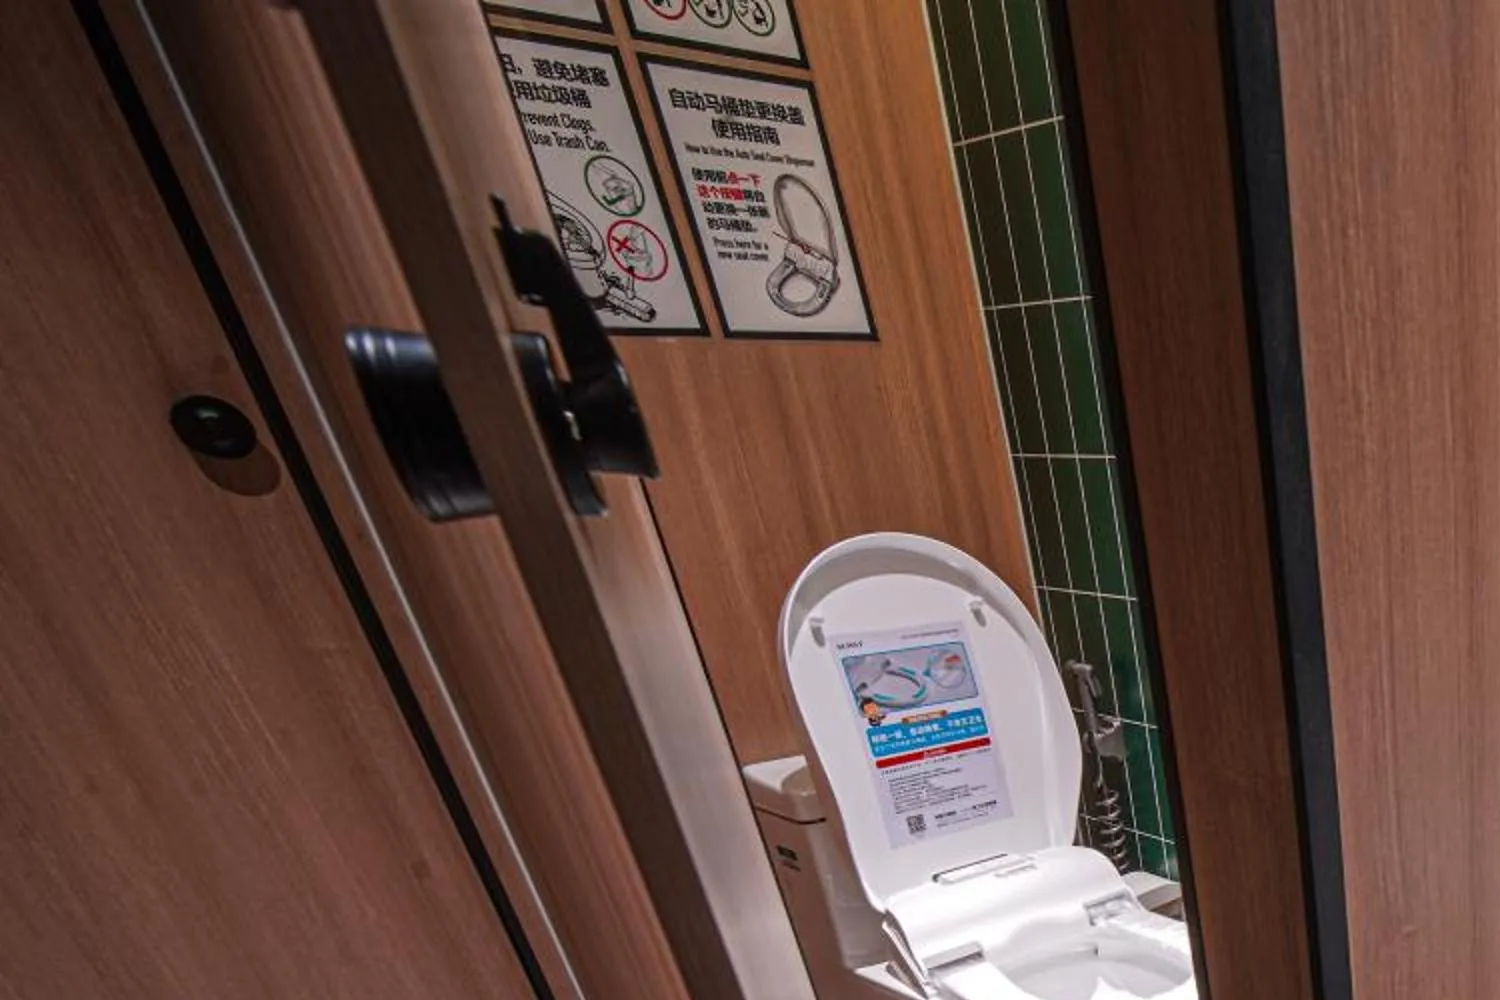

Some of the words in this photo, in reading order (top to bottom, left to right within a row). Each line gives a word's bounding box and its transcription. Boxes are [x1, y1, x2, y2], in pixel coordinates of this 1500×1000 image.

[513, 80, 592, 108] 用垃圾桶
[521, 112, 560, 127] revent
[712, 118, 781, 146] 使用指南
